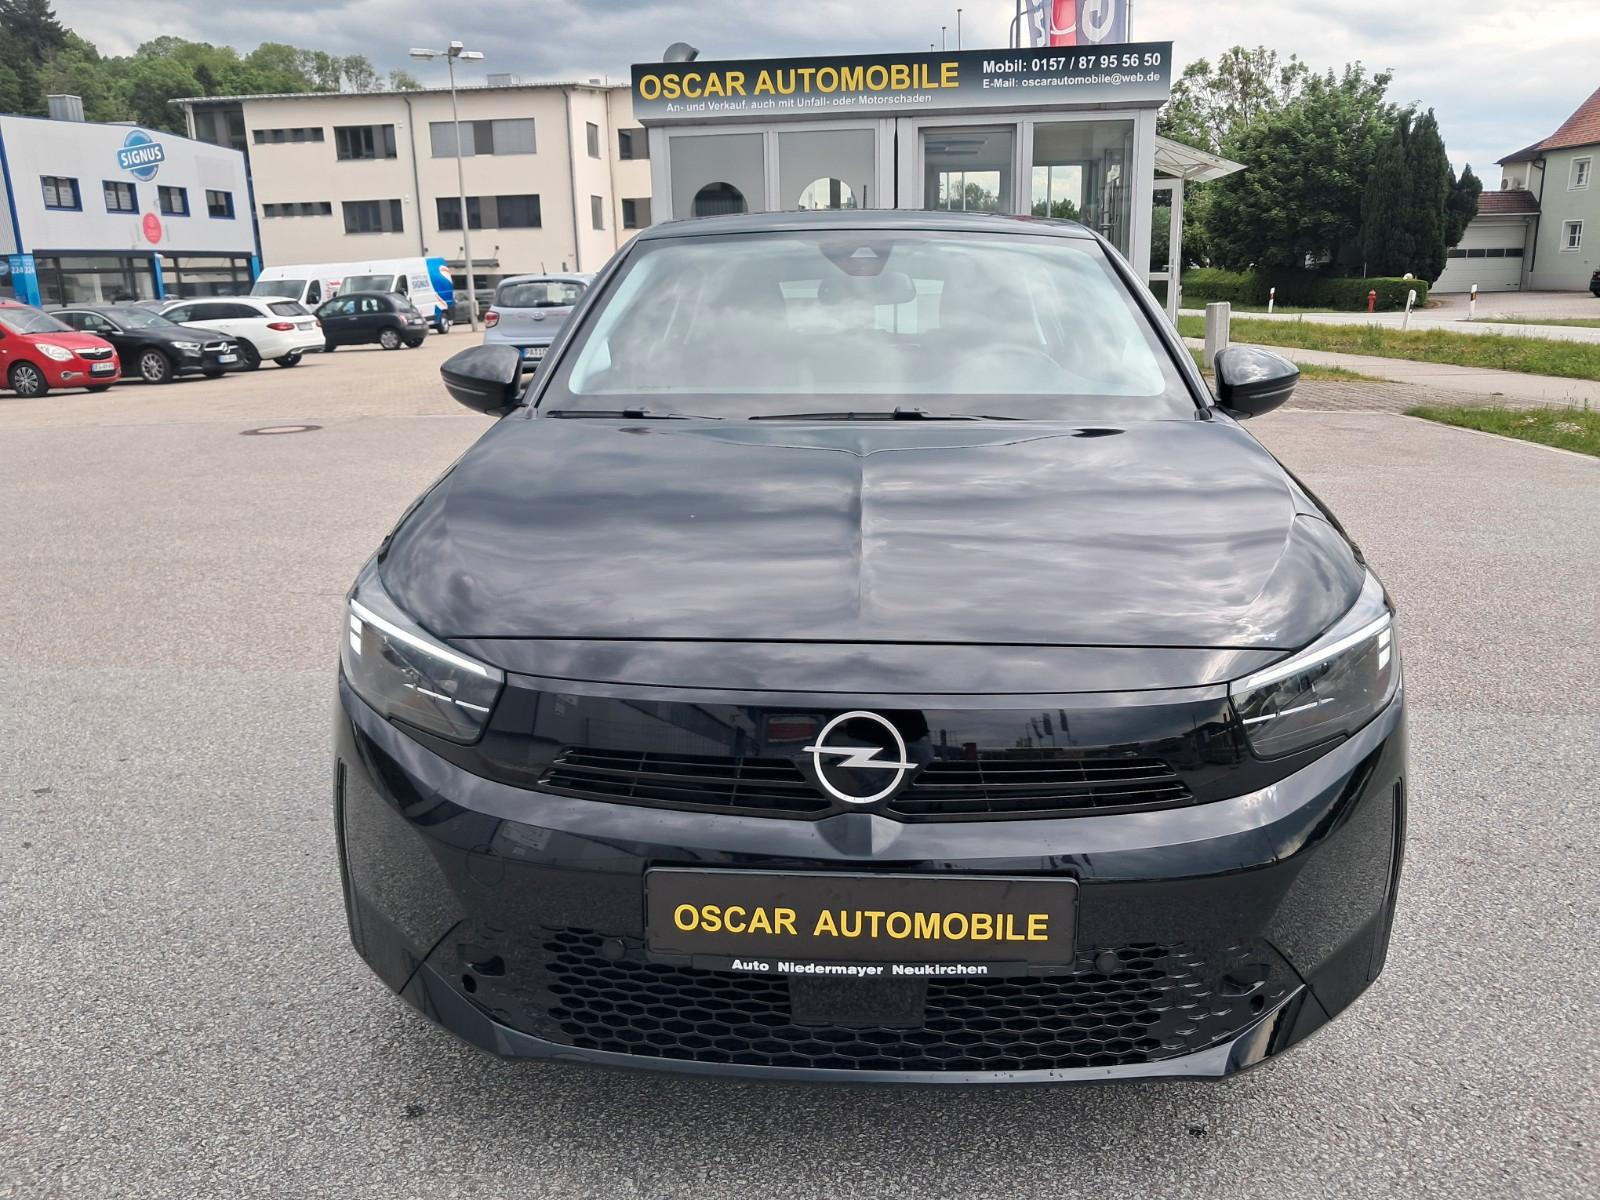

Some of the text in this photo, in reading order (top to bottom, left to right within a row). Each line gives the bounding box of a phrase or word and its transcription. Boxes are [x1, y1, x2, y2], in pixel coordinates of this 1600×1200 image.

[982, 52, 1161, 73] Mobil: 0157 / 87 95 56 50
[639, 62, 960, 100] OSCAR AUTOMOBILE
[982, 72, 1161, 88] E-Mail: oscarautomobile@web.de
[666, 94, 932, 112] An- und Verkauf, auch mit Unfall- oder Motorschaden
[120, 146, 162, 166] SIGNUS
[673, 904, 1050, 942] OSCAR AUTOMOBILE
[731, 959, 988, 978] Auto Niedermayer Neukirchen
